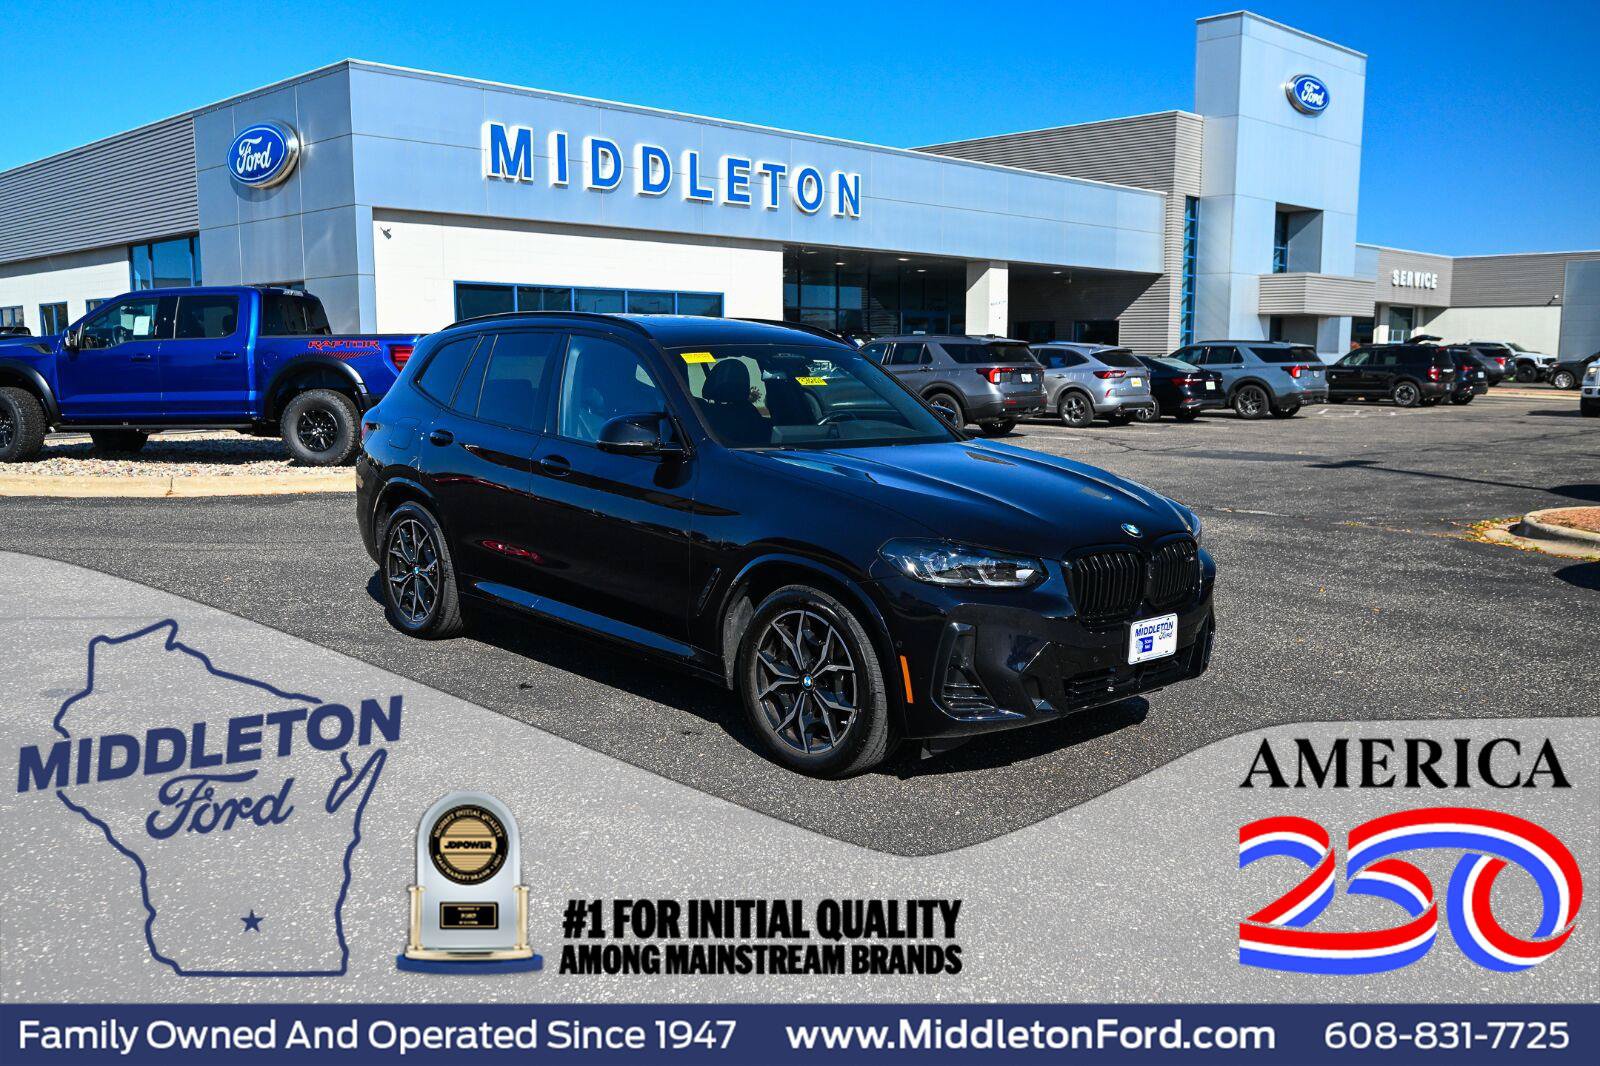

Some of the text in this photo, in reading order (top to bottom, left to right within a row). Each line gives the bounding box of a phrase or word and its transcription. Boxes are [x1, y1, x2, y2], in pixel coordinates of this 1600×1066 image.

[1301, 81, 1325, 106] Ford
[236, 136, 273, 174] Ford
[483, 120, 862, 218] MIDDLETON
[1392, 269, 1438, 289] SERVICE
[308, 340, 381, 351] RAPTOR
[1135, 621, 1174, 637] MIDDLETON
